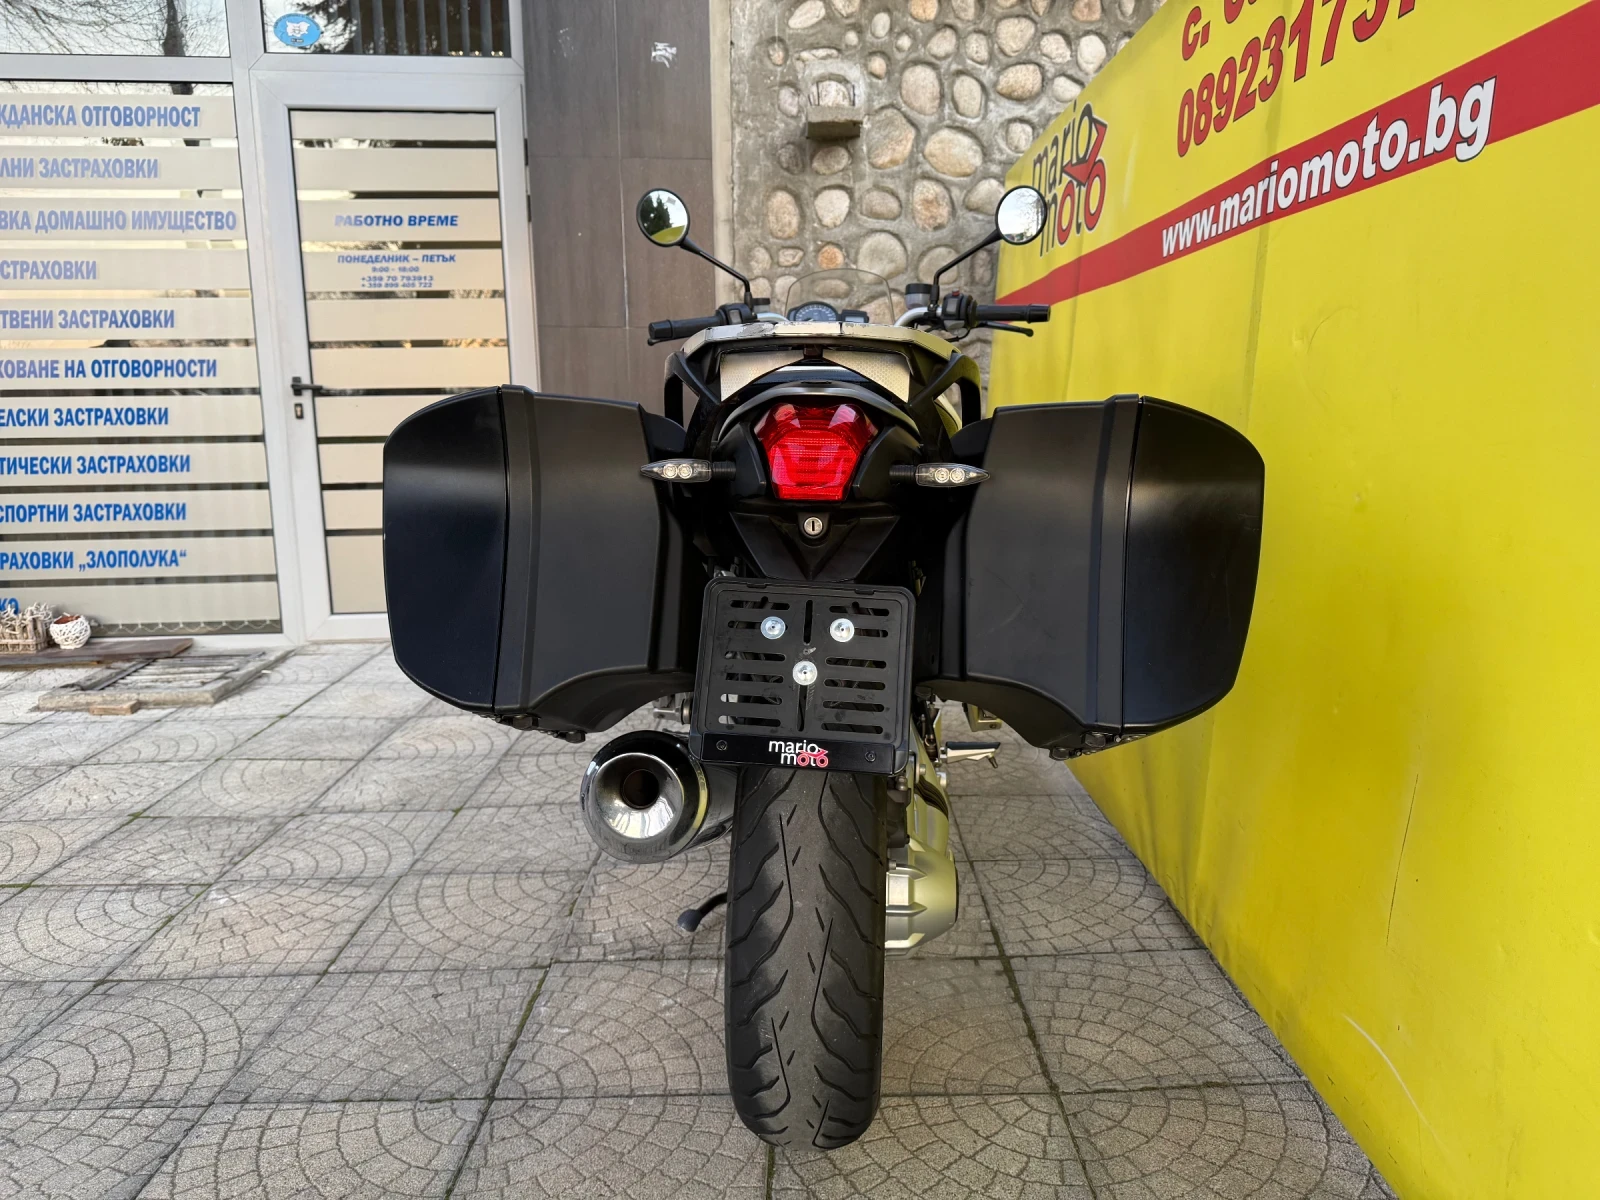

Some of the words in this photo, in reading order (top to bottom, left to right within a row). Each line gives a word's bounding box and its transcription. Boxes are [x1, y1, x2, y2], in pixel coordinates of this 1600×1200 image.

[1177, 0, 1415, 158] 0892317
[81, 105, 201, 127] ОТГОВОРНОСТ
[1032, 99, 1093, 197] mario
[0, 157, 34, 178] ЛНИ
[38, 158, 159, 178] ЗАСТРАХОВКИ
[1161, 75, 1497, 258] www.mariomoto.bg
[0, 210, 31, 230] ВКА
[35, 210, 127, 233] ДОМАШНО
[131, 210, 237, 232] ИМУЩЕСТВО
[334, 215, 403, 227] РАБОТНО
[407, 215, 458, 227] ВРЕМЕ
[337, 255, 410, 264] ПОНЕДЕЛНИК
[421, 254, 456, 263] ПЕТЪК
[0, 260, 97, 280] СТРАХОВКИ
[0, 309, 53, 329] ТВЕНИ
[58, 309, 175, 329] ЗАСТРАХОВКИ
[64, 359, 87, 378] НА
[91, 358, 217, 378] ОТГОВОРНОСТИ
[53, 407, 169, 427] ЗАСТРАХОВКИ
[77, 454, 190, 475] ЗАСТРАХОВКИ
[73, 502, 187, 523] ЗАСТРАХОВКИ
[0, 551, 74, 570] РАХОВКИ
[768, 739, 820, 754] mario
[780, 752, 829, 768] moto
